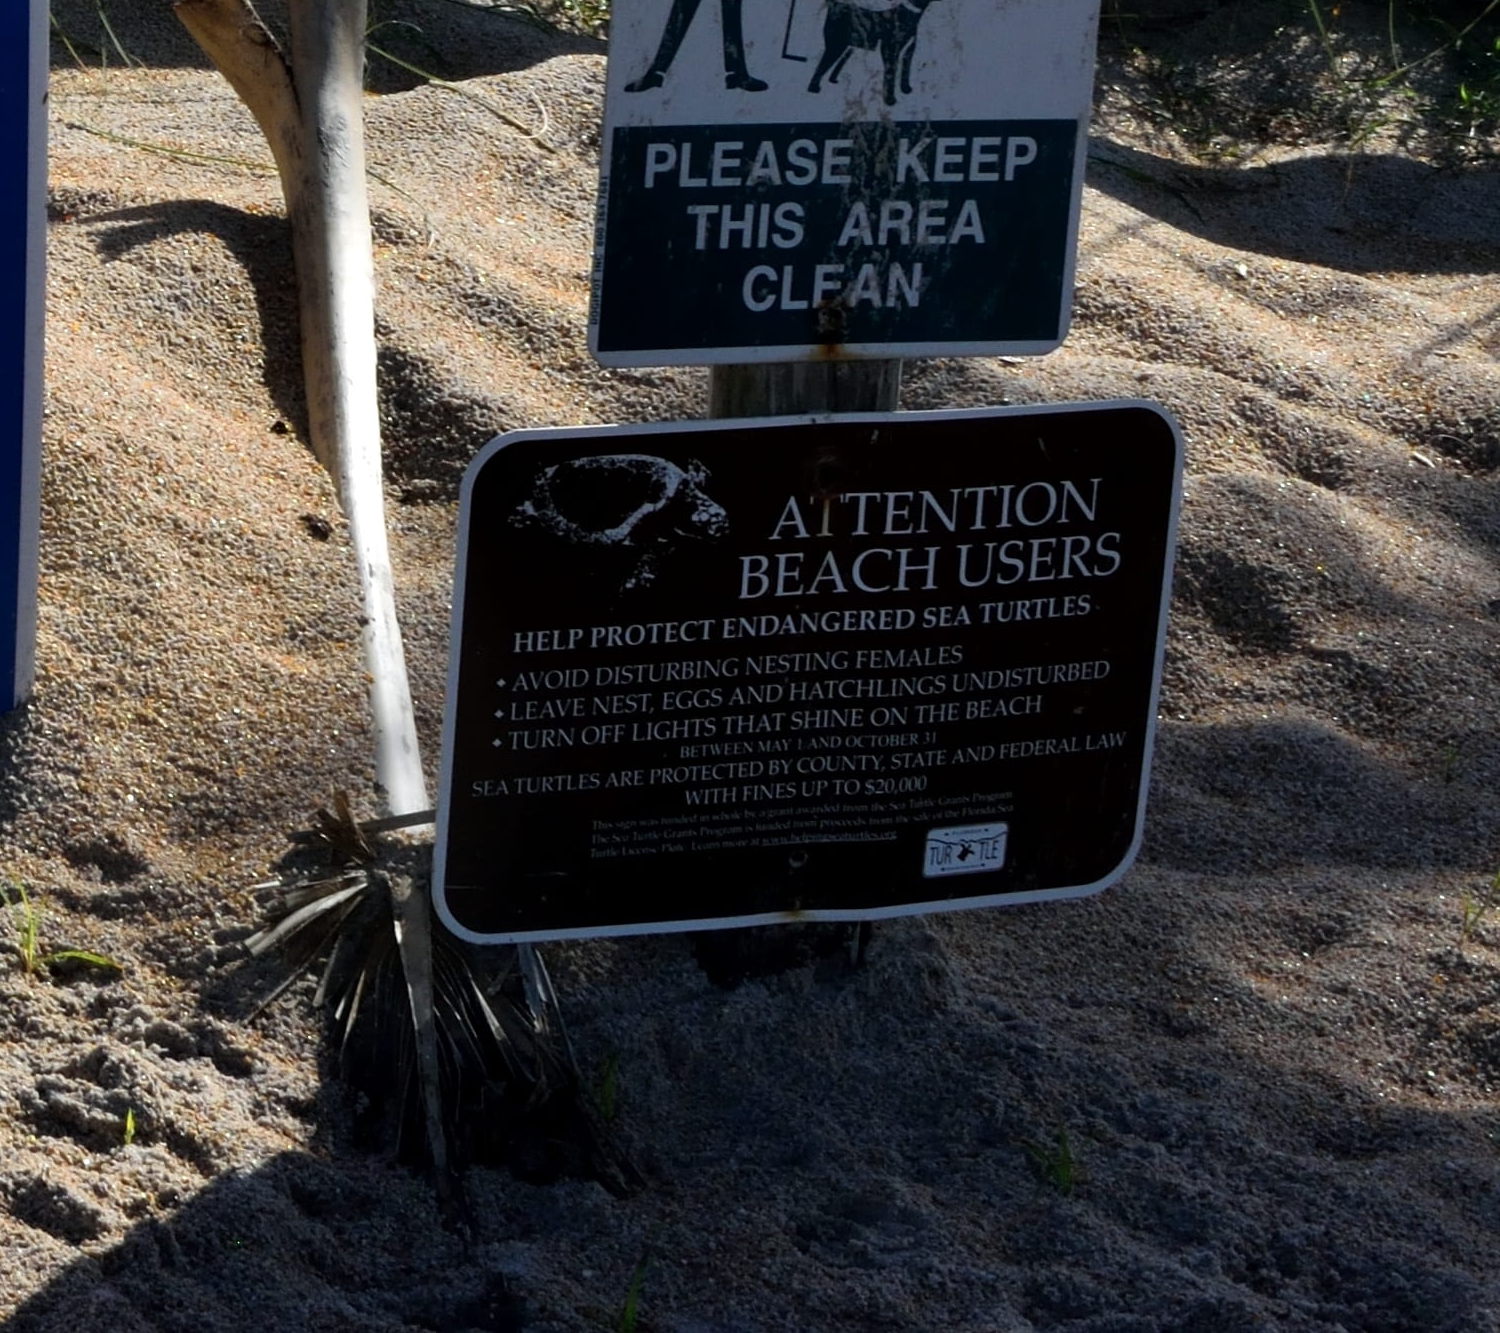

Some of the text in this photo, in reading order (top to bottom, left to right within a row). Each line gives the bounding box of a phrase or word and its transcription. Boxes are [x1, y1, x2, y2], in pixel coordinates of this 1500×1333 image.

[644, 136, 1037, 188] PLEASE KEEP
[687, 198, 984, 250] THIS AREA
[589, 278, 603, 325] DOGIPOT
[742, 262, 924, 311] CLEAN
[771, 478, 1102, 541] ATTENTION
[739, 532, 1120, 601] BEACH USERS
[514, 594, 1090, 652] HELP PROTECT ENDANGERED SEA TURTLES
[510, 660, 1110, 721] LEAVE NEST, EGGS AND HATCHLINGS UNDISTURBED
[512, 644, 963, 691] AVOID DISTURBING NESTING FEMALES
[508, 694, 1041, 750] TURN OFF LIGHTS THAT SHINE ON THE BEACH
[679, 741, 753, 758] BETWEEN
[757, 738, 791, 752] MAY
[808, 735, 842, 749] AND
[844, 732, 918, 749] OCTOBER
[923, 731, 936, 744] 31
[471, 731, 1126, 797] SEA TURTLES ARE PROTECTED BY COUNTY, STATE AND FEDERAL LAW
[685, 775, 927, 805] WITH FINES UP TO $20,000
[930, 840, 999, 866] TUR TLE
